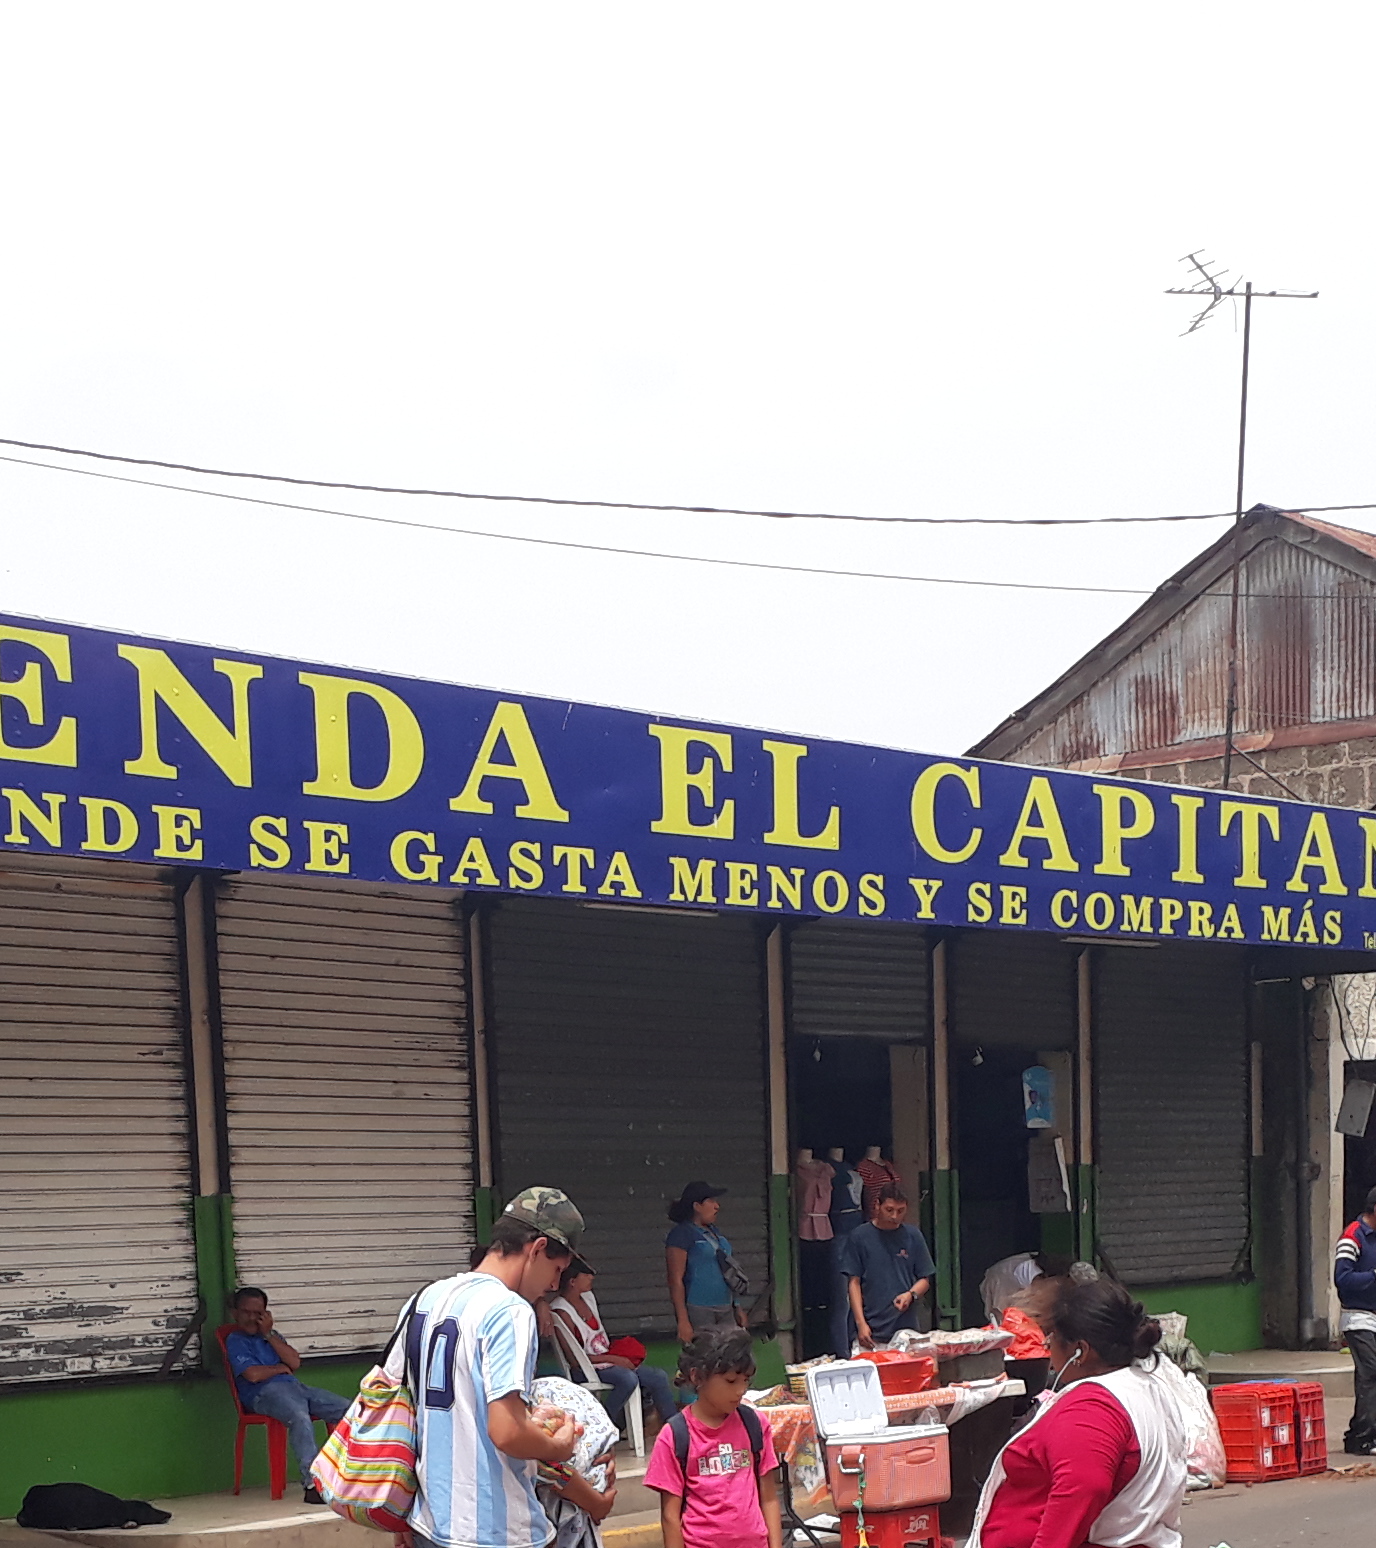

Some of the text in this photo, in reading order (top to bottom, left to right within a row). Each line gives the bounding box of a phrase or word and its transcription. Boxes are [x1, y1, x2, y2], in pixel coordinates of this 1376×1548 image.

[648, 722, 841, 852] EL
[249, 815, 352, 875] SE
[389, 829, 644, 900] GASTA
[668, 855, 887, 918] MENOS
[908, 877, 944, 920] Y
[966, 880, 1029, 926] SE
[1050, 889, 1244, 941] COMPRA
[1260, 898, 1344, 946] MÁS
